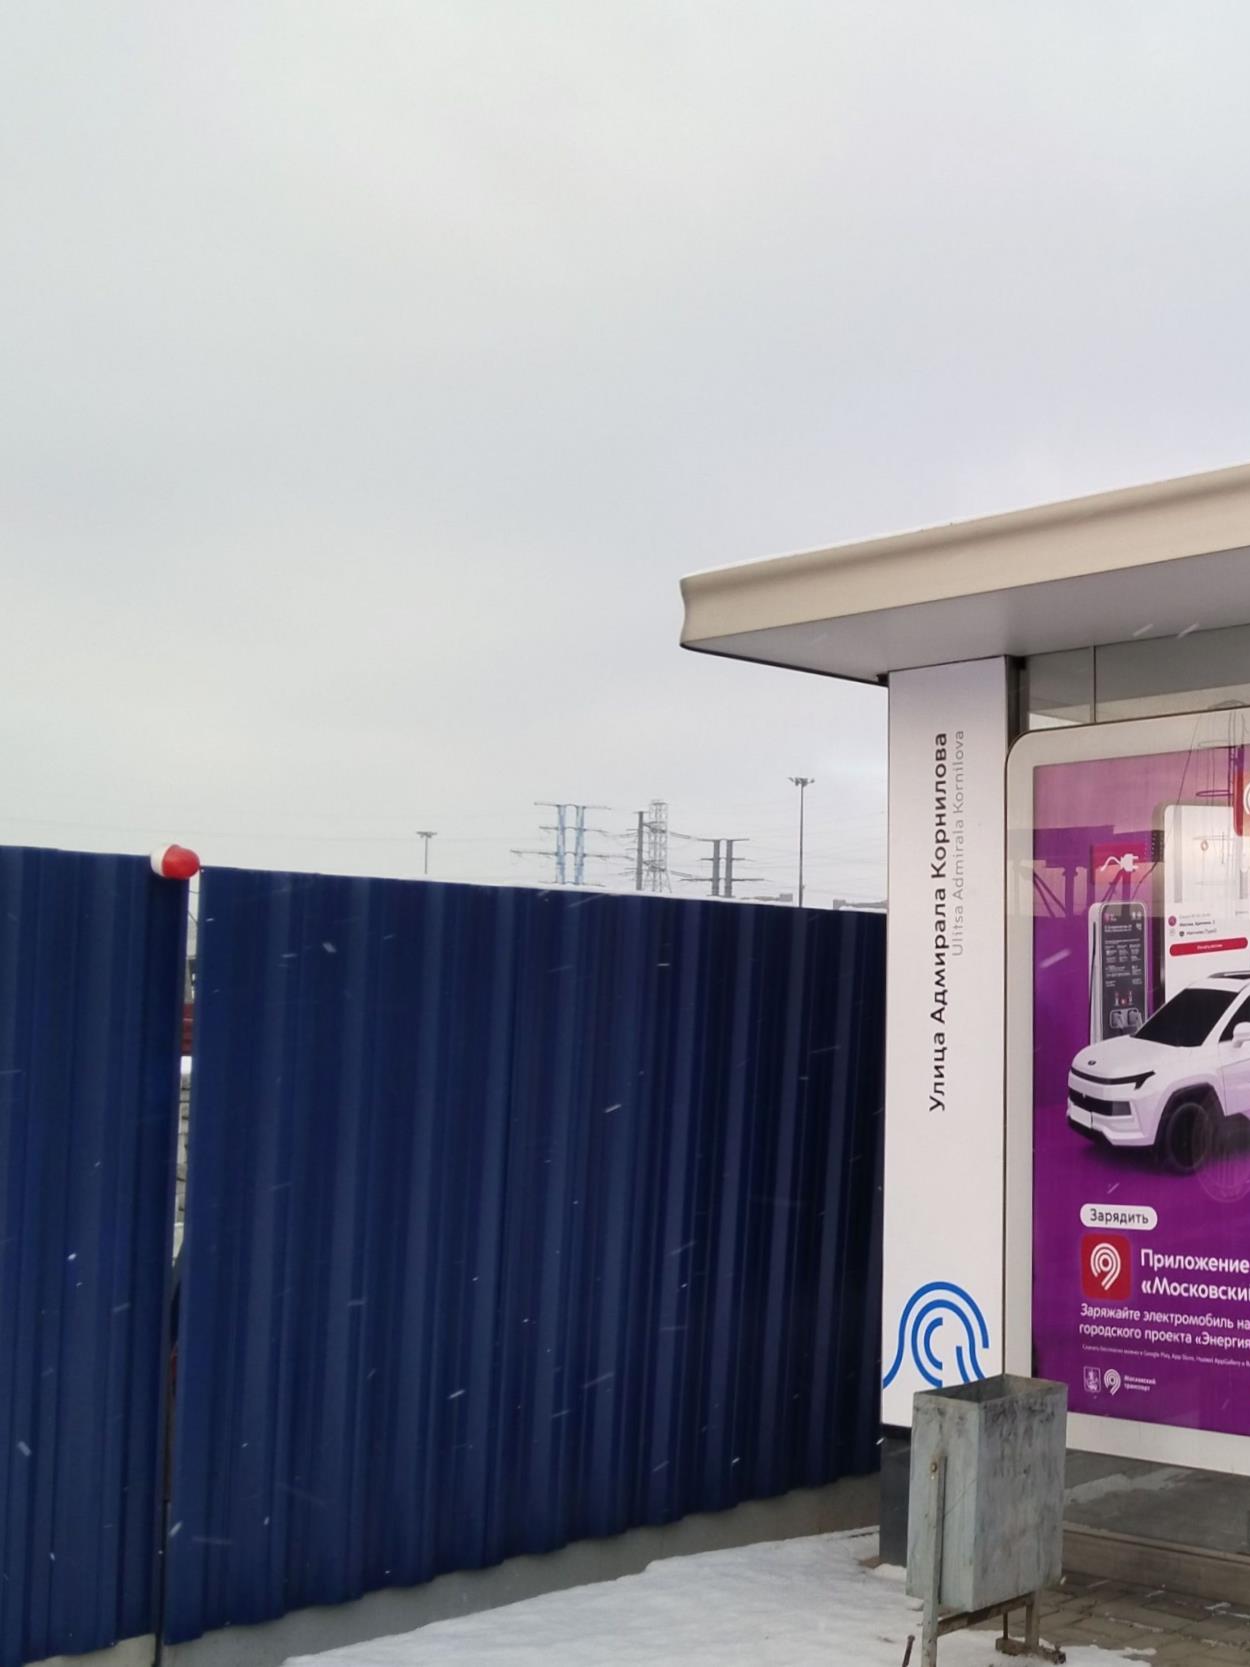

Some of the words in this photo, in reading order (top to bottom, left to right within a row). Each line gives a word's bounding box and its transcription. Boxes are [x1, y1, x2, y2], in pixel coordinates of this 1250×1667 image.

[953, 730, 965, 814] Kornilova
[931, 733, 950, 879] Корнилова
[953, 819, 965, 900] Admirala
[930, 887, 950, 1024] Адмирала
[952, 905, 964, 956] Ulitsa
[928, 1032, 945, 1112] Улица
[1089, 1208, 1149, 1225] Зарядить
[1140, 1249, 1250, 1274] Приложение
[1079, 1323, 1142, 1341] городского
[1144, 1329, 1192, 1346] проекта
[1195, 1332, 1250, 1350] «Энергия
[1080, 1303, 1141, 1322] Заряжайте
[1143, 1310, 1234, 1330] электромобиль
